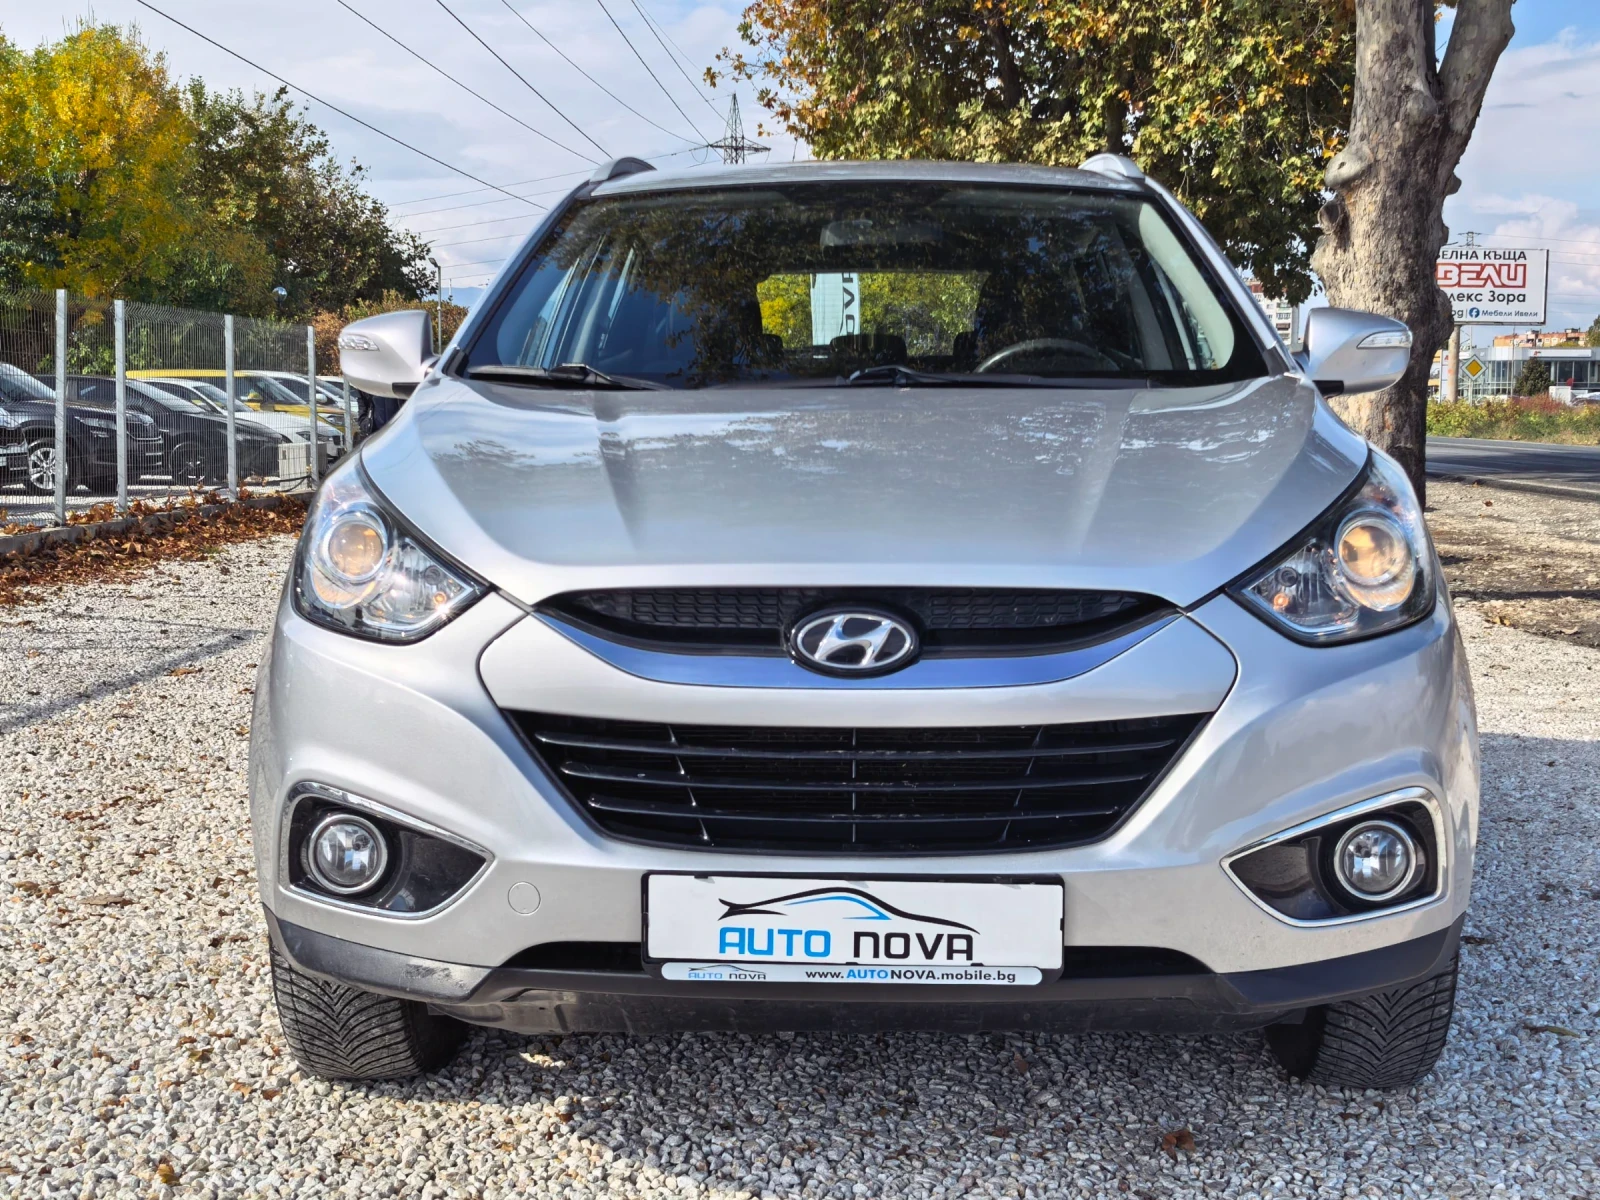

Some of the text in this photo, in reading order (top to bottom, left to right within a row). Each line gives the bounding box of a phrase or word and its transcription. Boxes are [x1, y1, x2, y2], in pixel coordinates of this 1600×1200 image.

[1438, 250, 1527, 262] ЕЛНА КЪЩА
[1447, 290, 1526, 305] лекс Зора
[1481, 309, 1512, 317] Мебели
[719, 927, 974, 960] AUTO NOVA
